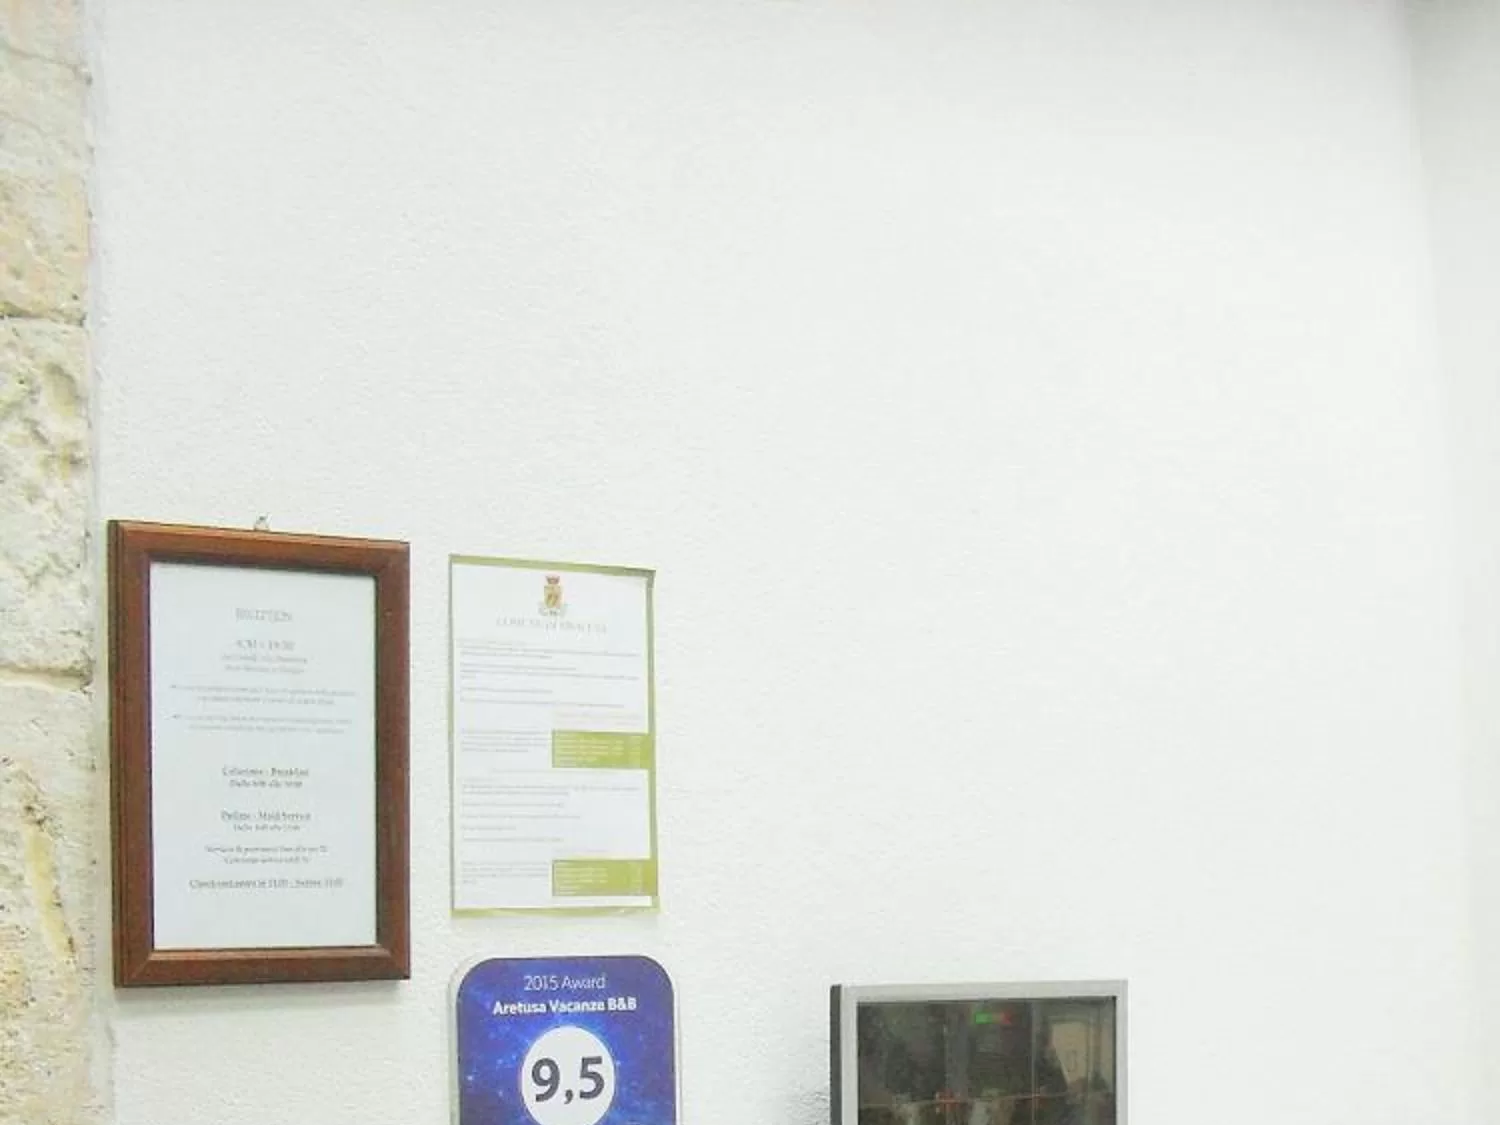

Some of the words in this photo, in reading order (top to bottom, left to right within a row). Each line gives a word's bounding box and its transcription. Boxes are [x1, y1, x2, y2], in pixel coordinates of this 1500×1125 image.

[524, 975, 559, 991] 2015
[561, 973, 607, 990] Award
[493, 1000, 547, 1016] Aretusa
[607, 996, 638, 1012] B&B
[530, 1055, 606, 1105] 9,5
